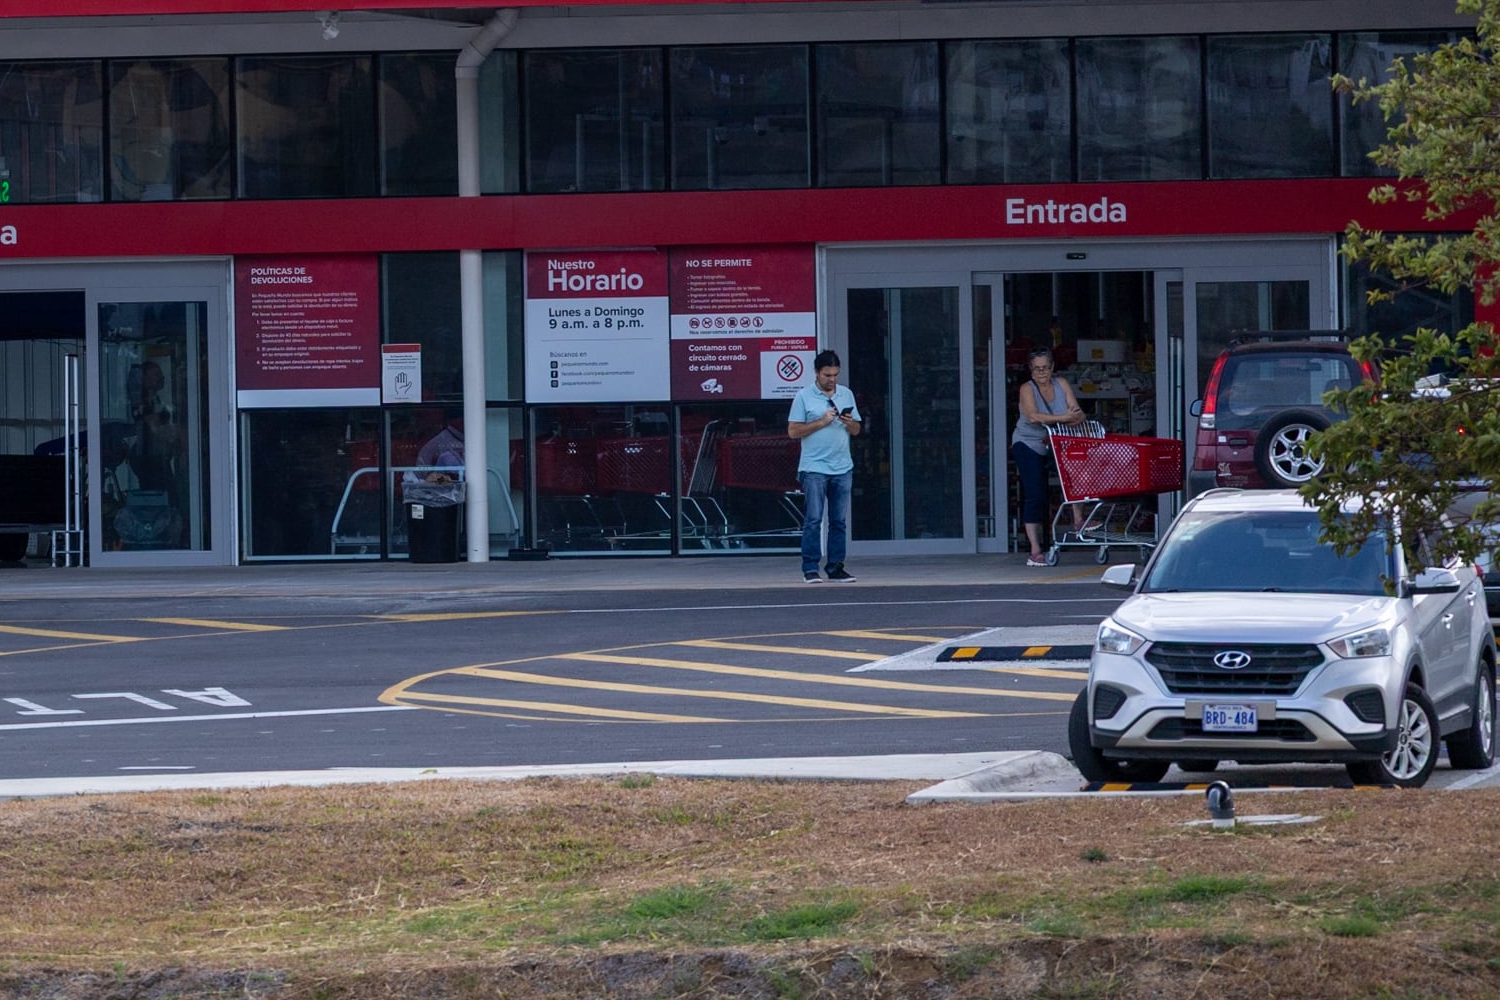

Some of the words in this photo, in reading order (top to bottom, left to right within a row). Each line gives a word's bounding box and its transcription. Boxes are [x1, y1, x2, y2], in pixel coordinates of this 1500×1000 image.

[1006, 197, 1127, 224] Entrada
[548, 259, 595, 270] Nuestro
[686, 260, 700, 268] NO
[714, 259, 752, 267] PERMITE
[251, 266, 292, 275] POLÍTICAS
[294, 267, 306, 275] DE
[251, 276, 313, 284] DEVOLUCIONES
[548, 267, 643, 291] Horario
[549, 308, 581, 317] Lunes
[584, 309, 591, 317] a
[595, 306, 644, 318] Domingo
[549, 319, 557, 329] 9
[561, 320, 588, 329] a.m.
[593, 320, 600, 328] a
[605, 318, 612, 328] 8
[617, 319, 644, 330] p.m.
[688, 344, 726, 352] Contamos
[688, 354, 717, 362] circuito
[718, 353, 747, 361] cerrado
[688, 364, 699, 372] de
[700, 363, 732, 371] cámaras
[1206, 711, 1254, 725] BRD-484
